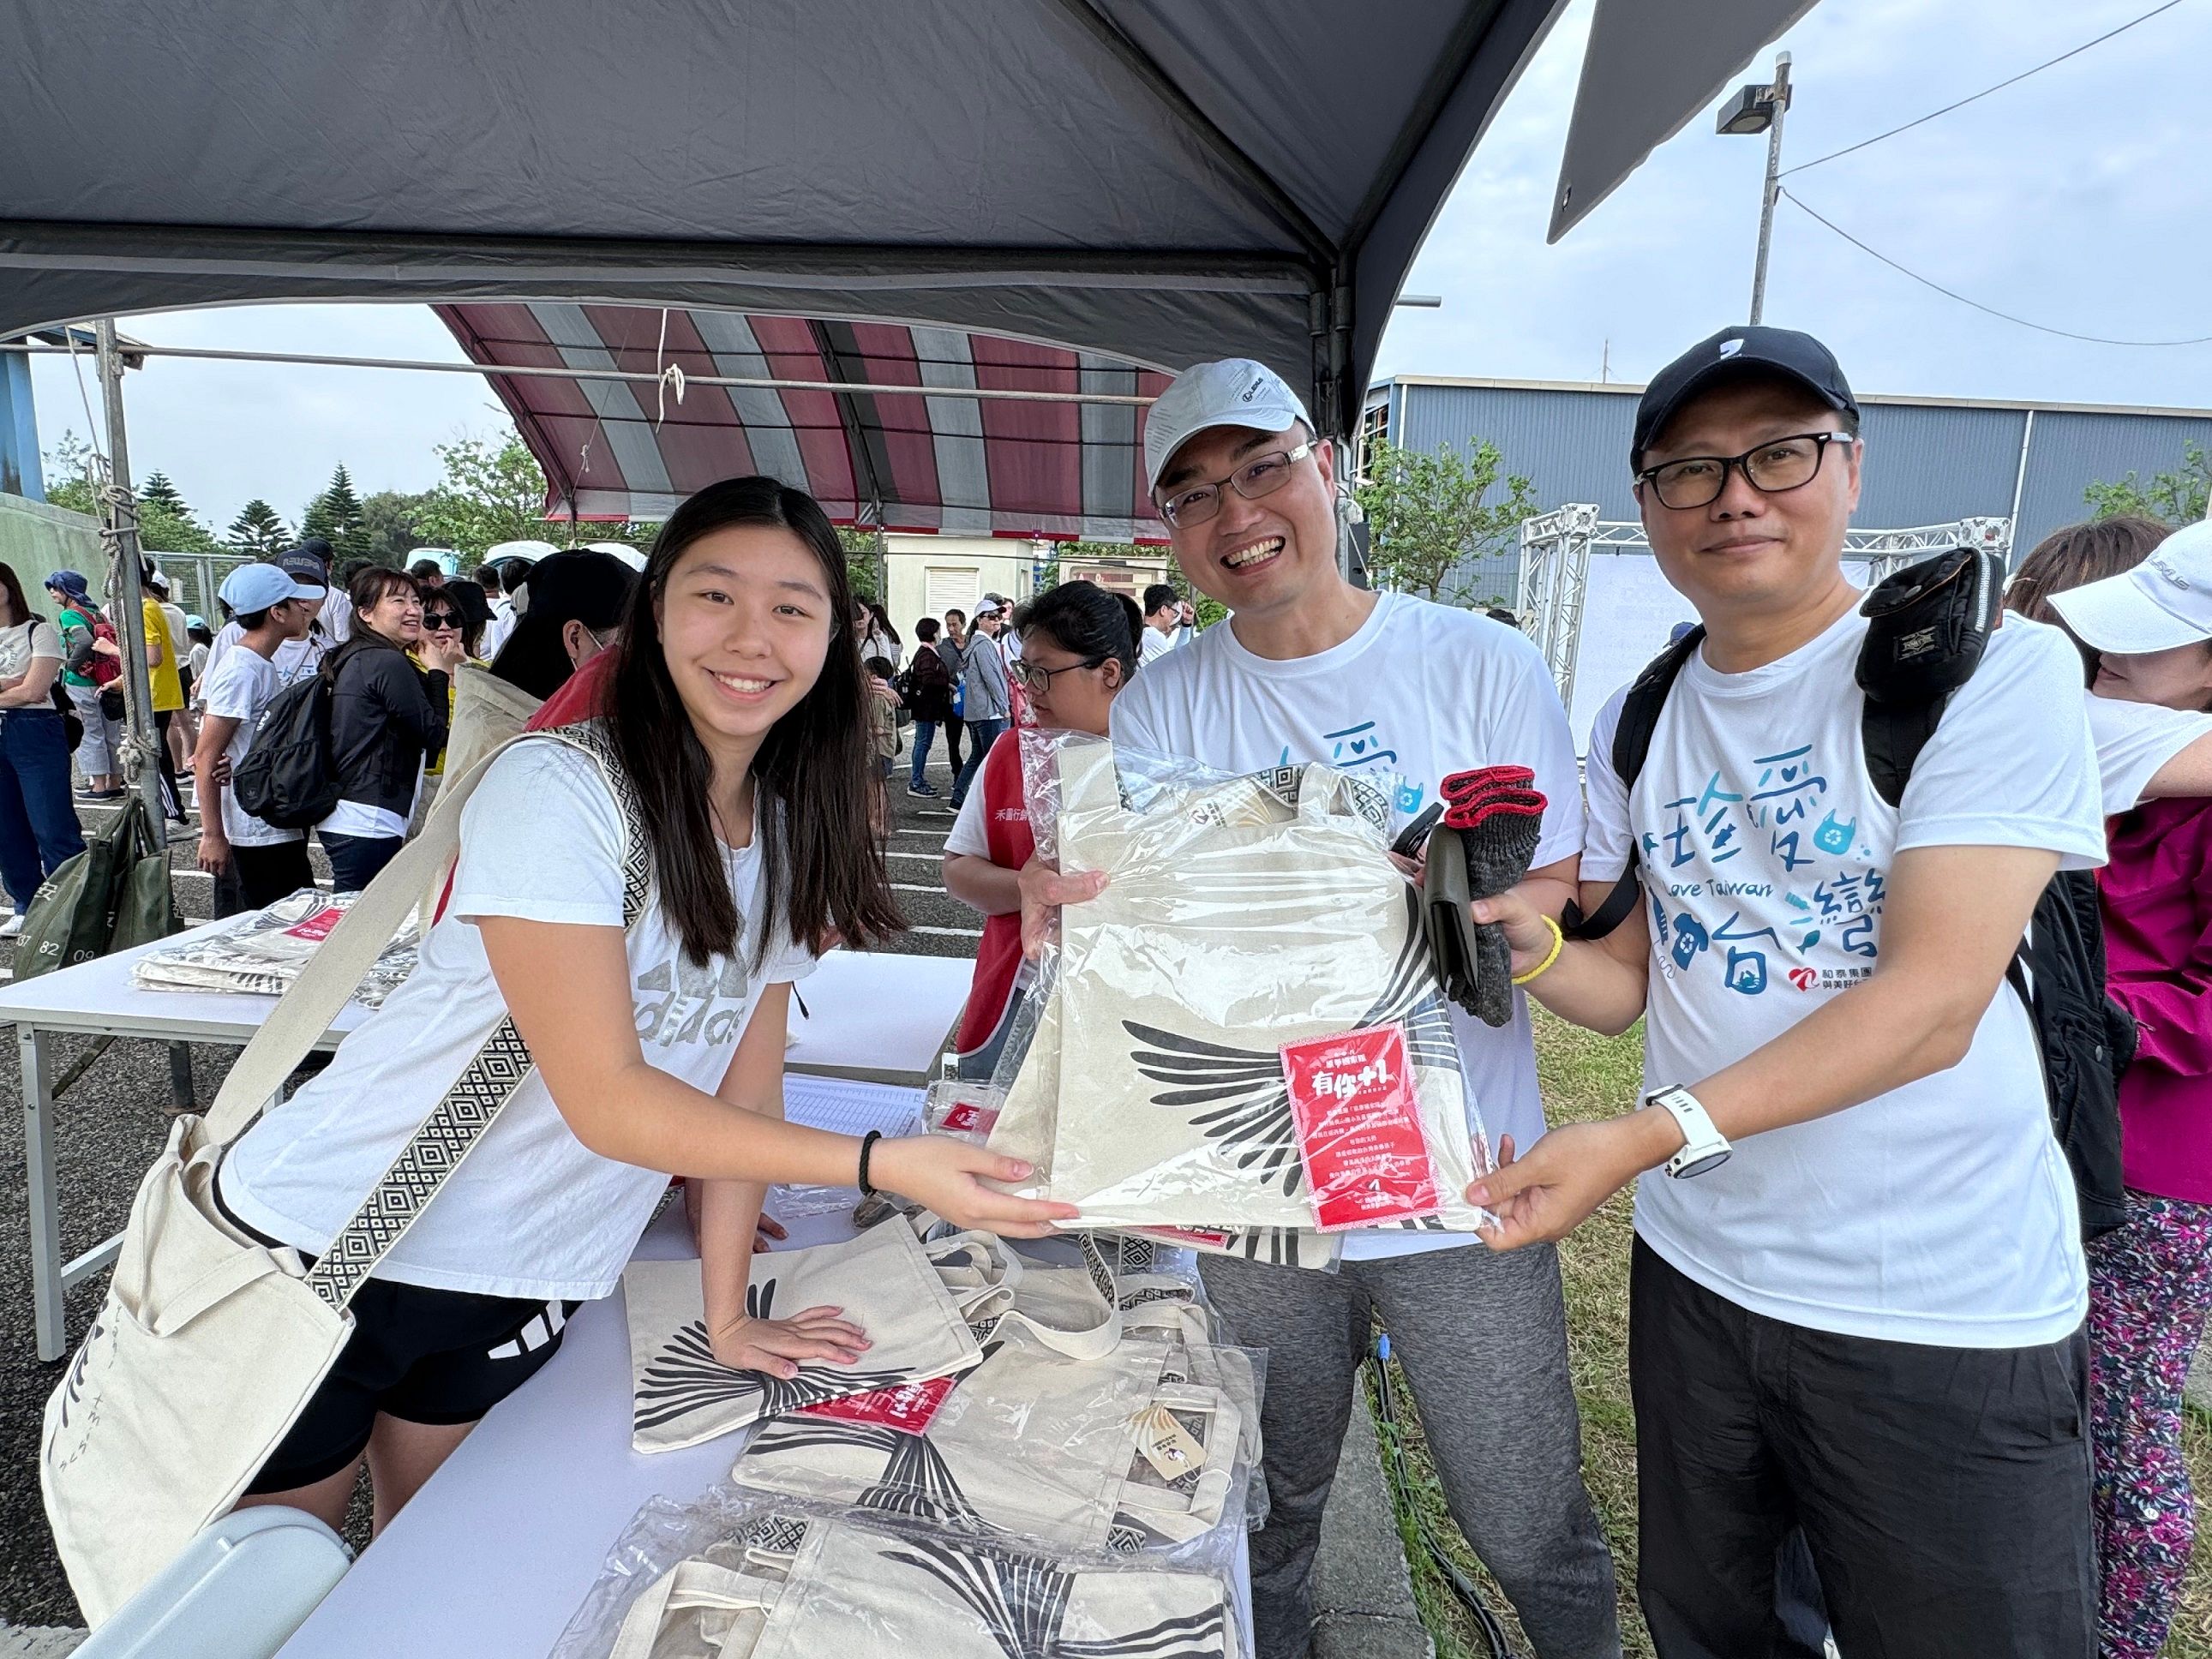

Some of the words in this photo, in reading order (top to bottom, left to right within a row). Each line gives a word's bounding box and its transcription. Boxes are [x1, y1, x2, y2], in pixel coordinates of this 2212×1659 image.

[1705, 878, 1773, 897] Taiwan
[39, 941, 59, 956] 82
[1312, 1059, 1388, 1098] 有你+1
